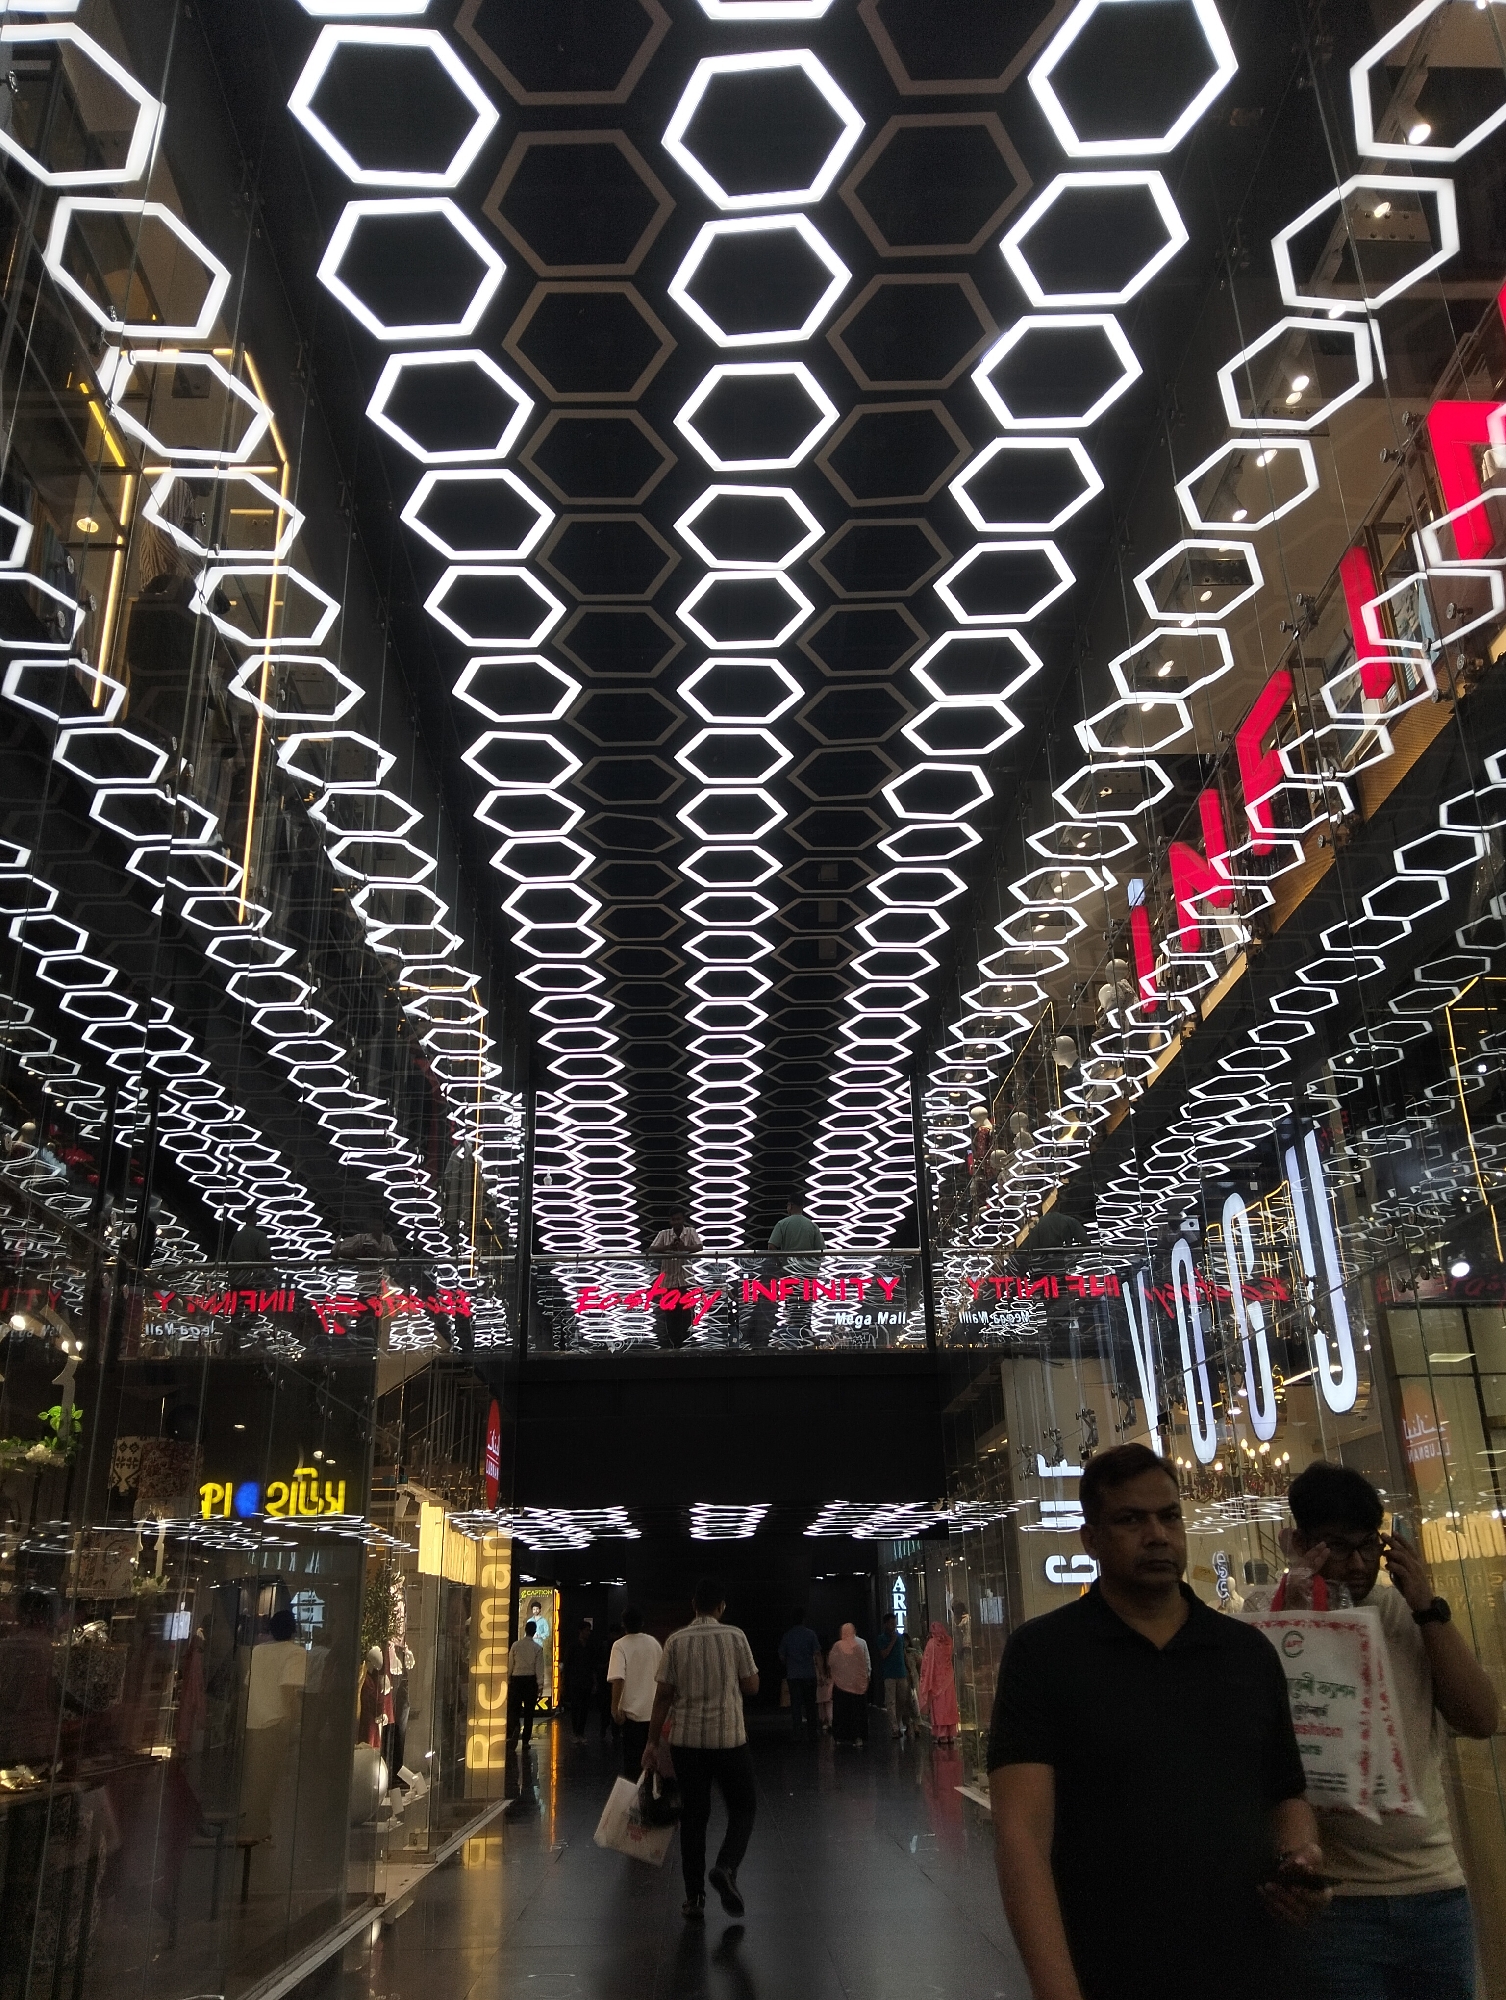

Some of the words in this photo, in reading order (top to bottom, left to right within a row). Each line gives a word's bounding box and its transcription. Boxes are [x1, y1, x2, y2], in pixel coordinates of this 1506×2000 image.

[575, 1272, 722, 1326] Ecstasy
[743, 1274, 900, 1303] INFINITY
[835, 1312, 872, 1329] Mega
[877, 1311, 907, 1325] Mall
[526, 1589, 553, 1597] CAPTION
[466, 1530, 512, 1769] Richman
